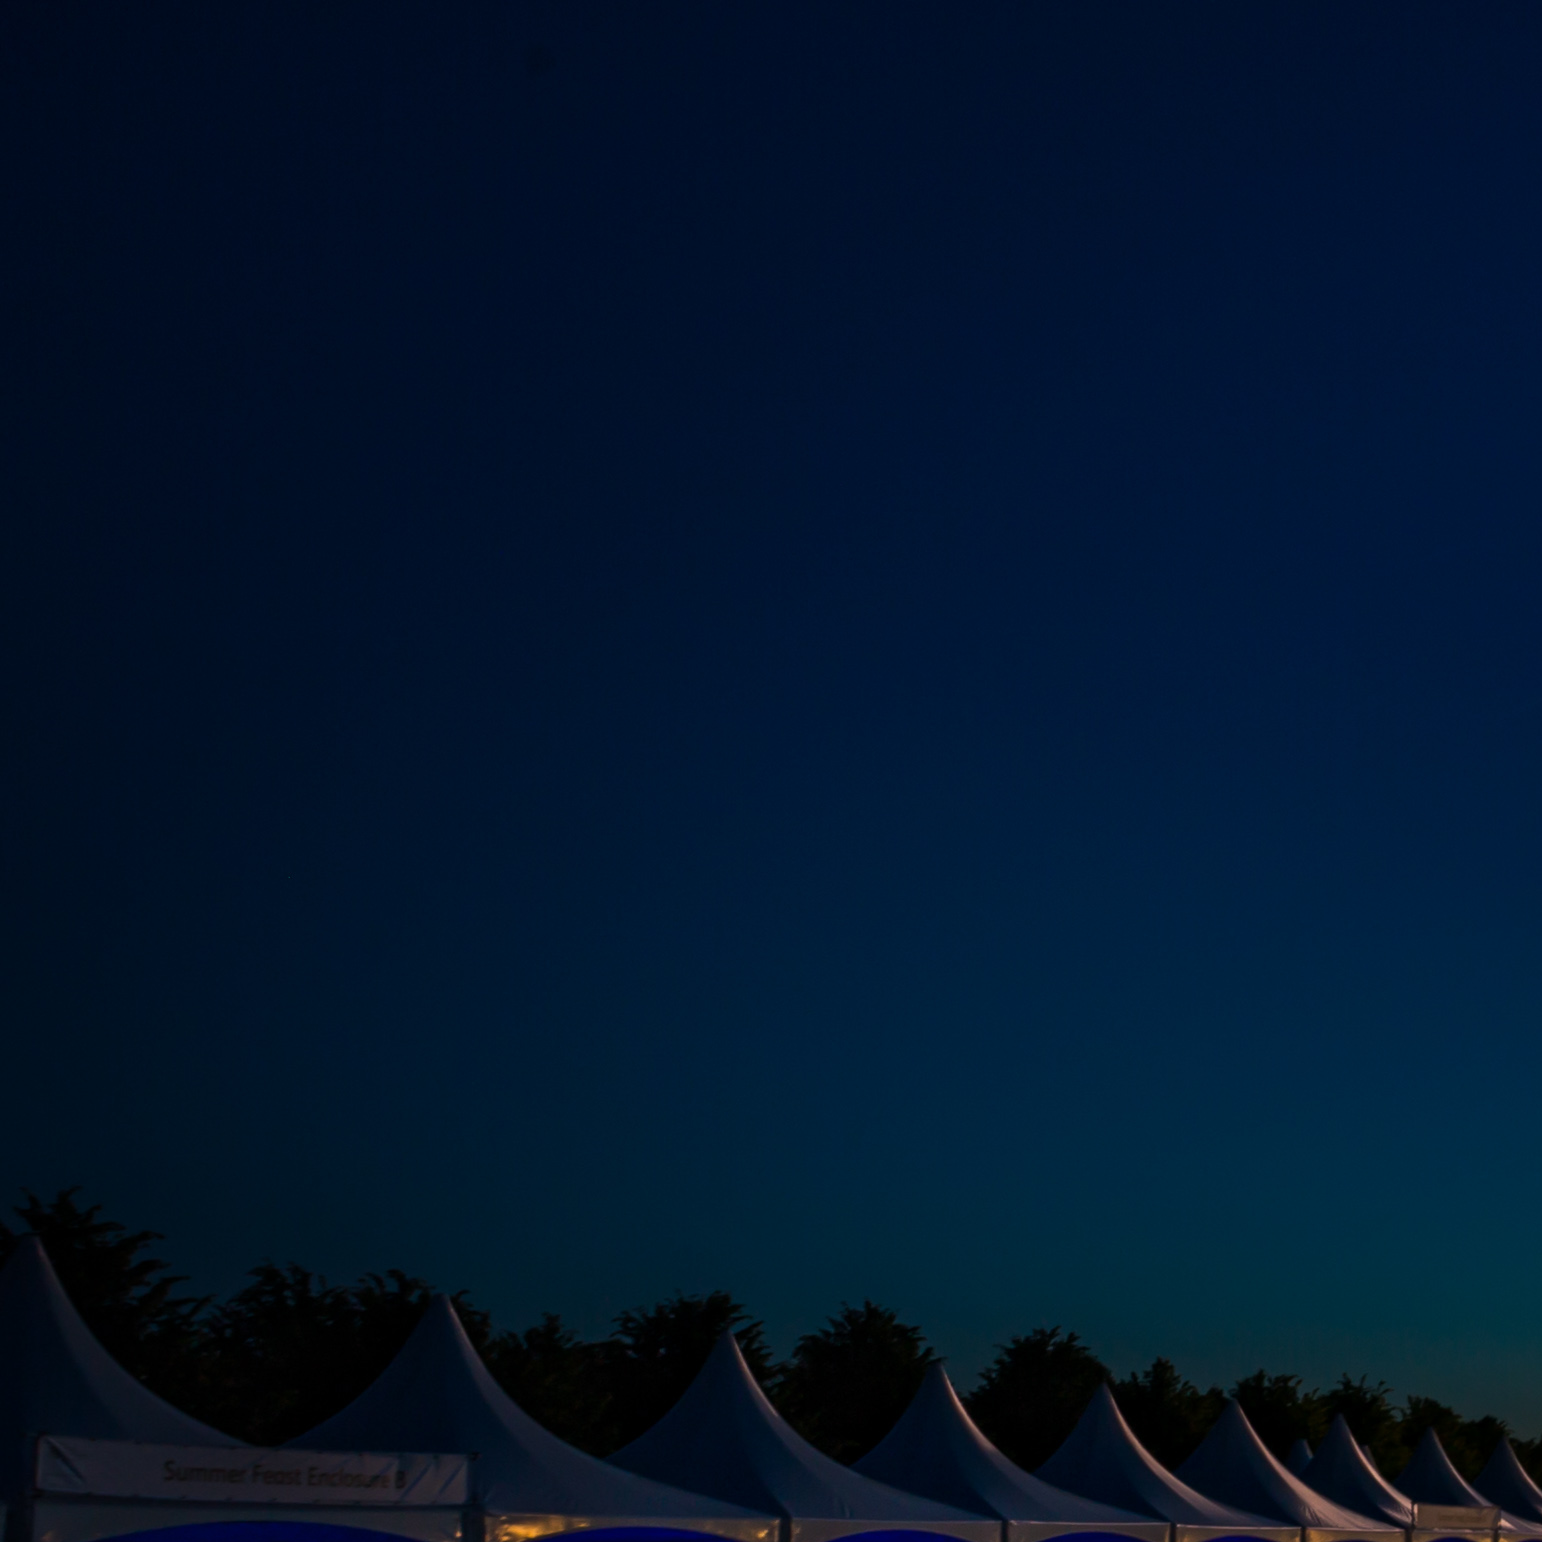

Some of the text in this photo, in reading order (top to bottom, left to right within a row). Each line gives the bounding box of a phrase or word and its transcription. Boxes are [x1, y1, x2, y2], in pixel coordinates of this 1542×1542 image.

[163, 1459, 407, 1490] Summer Feast Enclosure B
